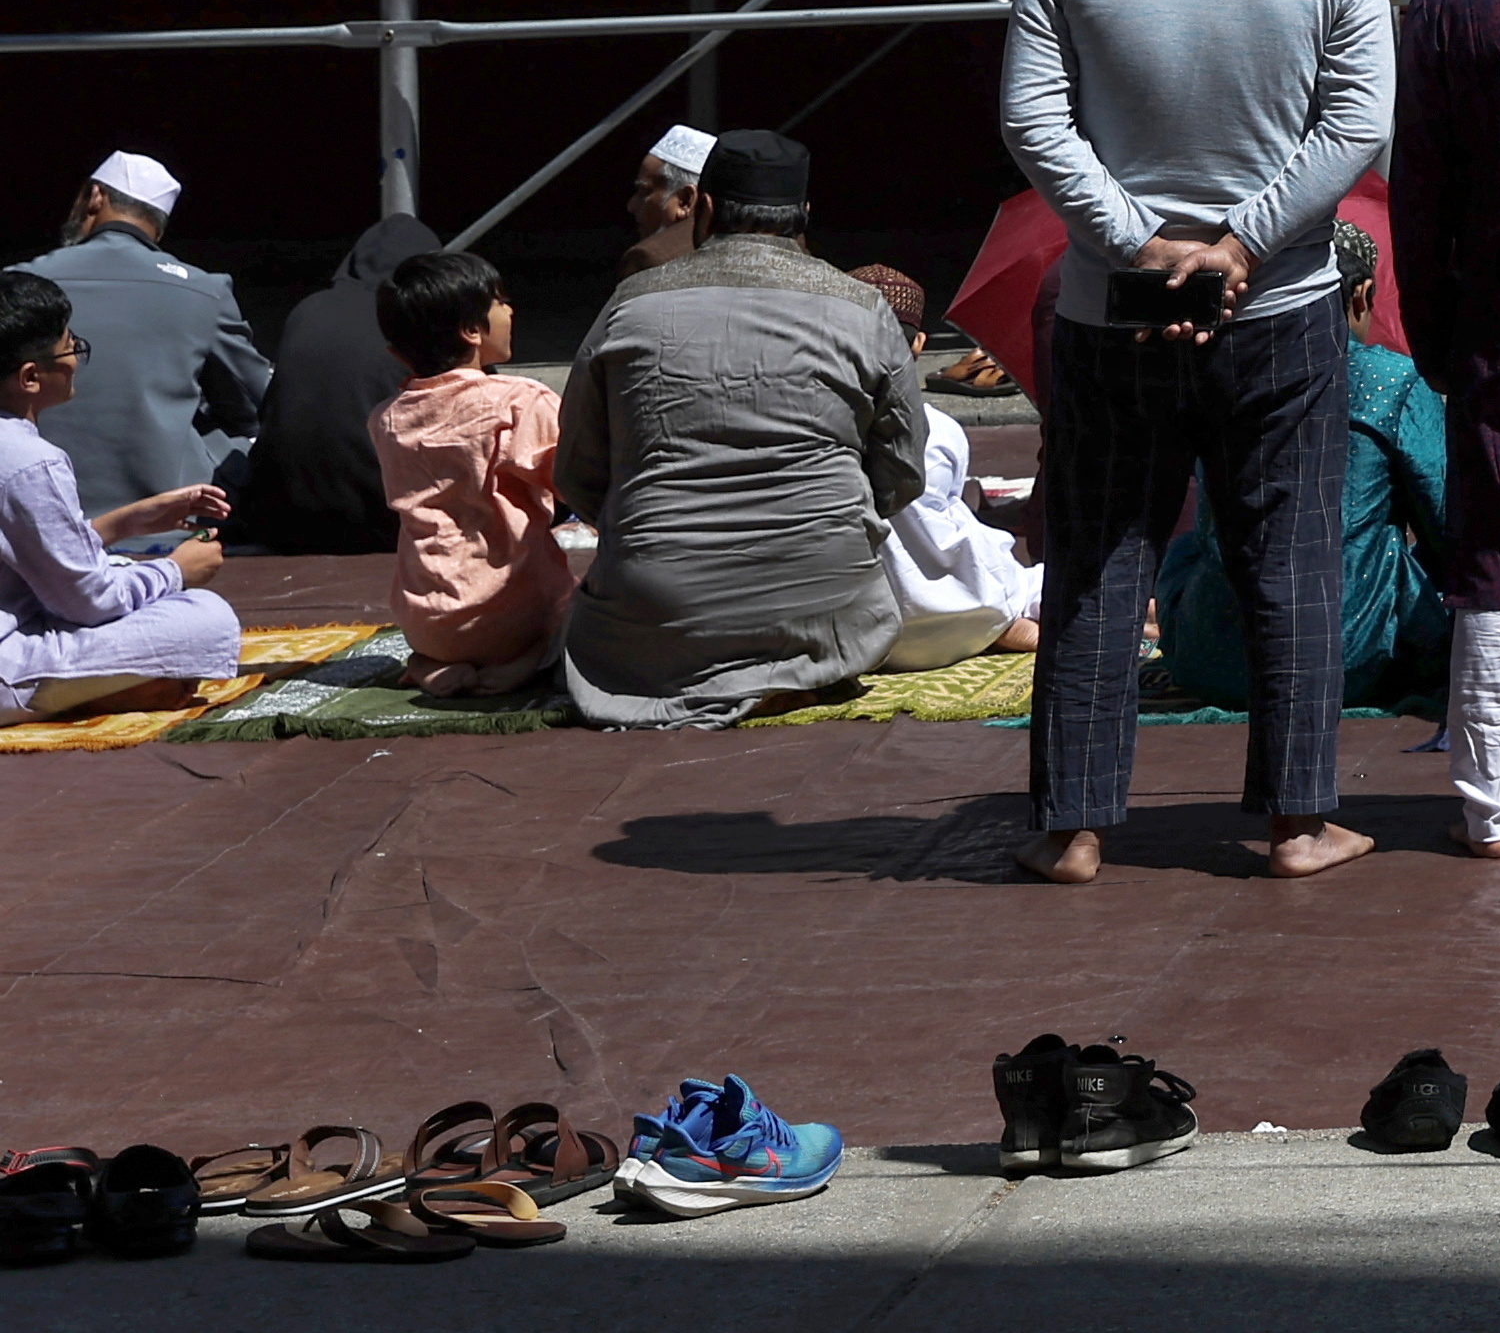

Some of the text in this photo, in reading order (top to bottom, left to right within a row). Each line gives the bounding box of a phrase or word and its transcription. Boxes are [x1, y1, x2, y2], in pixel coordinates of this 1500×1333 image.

[1006, 1069, 1034, 1084] NIKE
[1077, 1077, 1105, 1092] NIKE
[1413, 1083, 1440, 1096] UGG
